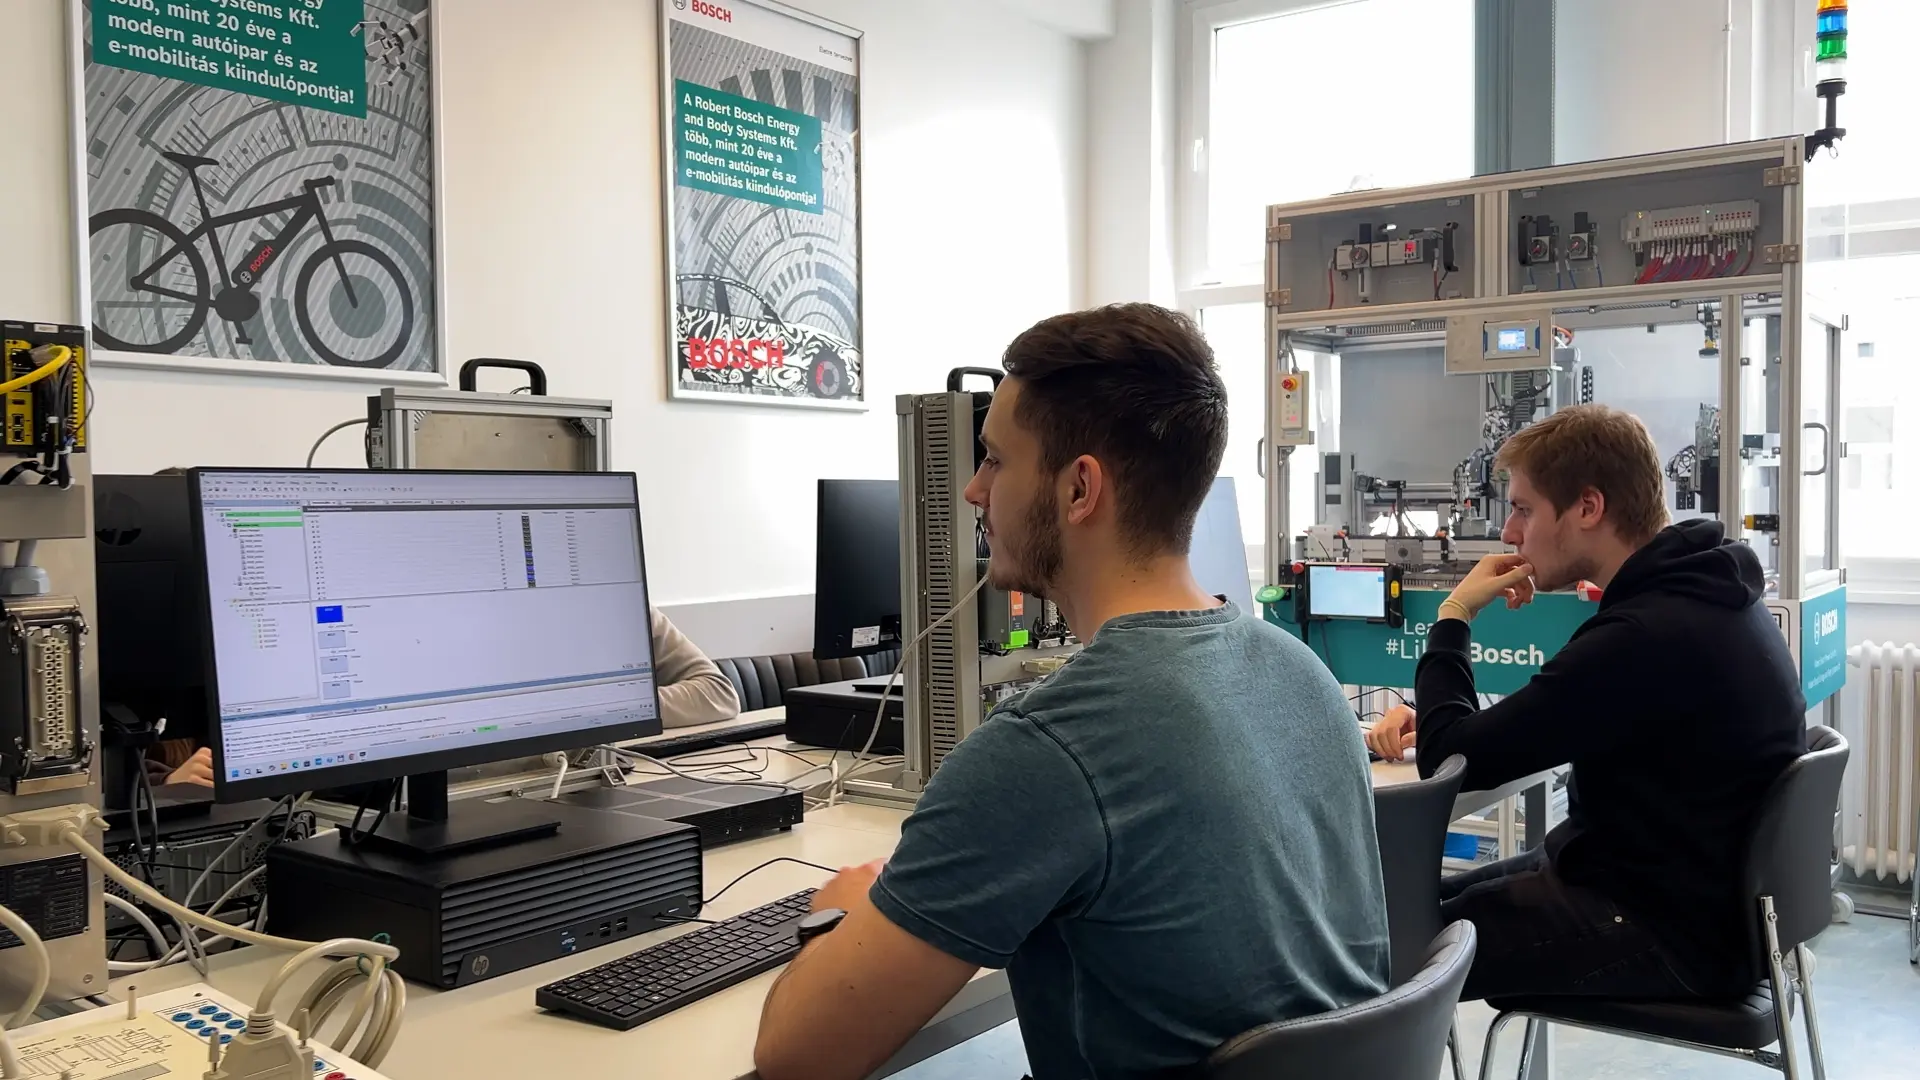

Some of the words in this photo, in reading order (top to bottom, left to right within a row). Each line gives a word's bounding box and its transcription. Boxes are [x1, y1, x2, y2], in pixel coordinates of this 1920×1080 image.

[167, 3, 211, 25] mint
[216, 12, 240, 32] 20
[245, 19, 277, 41] éve
[281, 32, 292, 45] a
[210, 0, 283, 20] ystems
[289, 7, 320, 29] Kft.
[692, 0, 731, 23] BOSCH
[108, 14, 185, 43] modern
[192, 33, 269, 61] autóipar
[274, 49, 294, 68] és
[299, 58, 318, 74] az
[108, 39, 219, 74] e-mobilitás
[224, 61, 354, 104] kiindulópontja!
[683, 93, 692, 106] A
[695, 96, 731, 117] Robert
[734, 106, 764, 126] Bosch
[767, 116, 800, 137] Energy
[684, 113, 704, 127] and
[707, 117, 734, 137] Body
[736, 124, 778, 146] Systems
[780, 135, 798, 151] Kft.
[685, 129, 712, 149] több,
[715, 138, 739, 154] mint
[741, 143, 755, 157] 20
[757, 147, 774, 162] éve
[776, 154, 783, 164] a
[685, 150, 726, 168] modern
[729, 160, 770, 178] autóipar
[772, 167, 784, 181] és
[785, 173, 797, 184] az
[685, 168, 744, 189] e-mobilitás
[745, 178, 817, 206] kiindulópontja!
[249, 245, 273, 272] BOSCH
[688, 336, 784, 369] BOSCH
